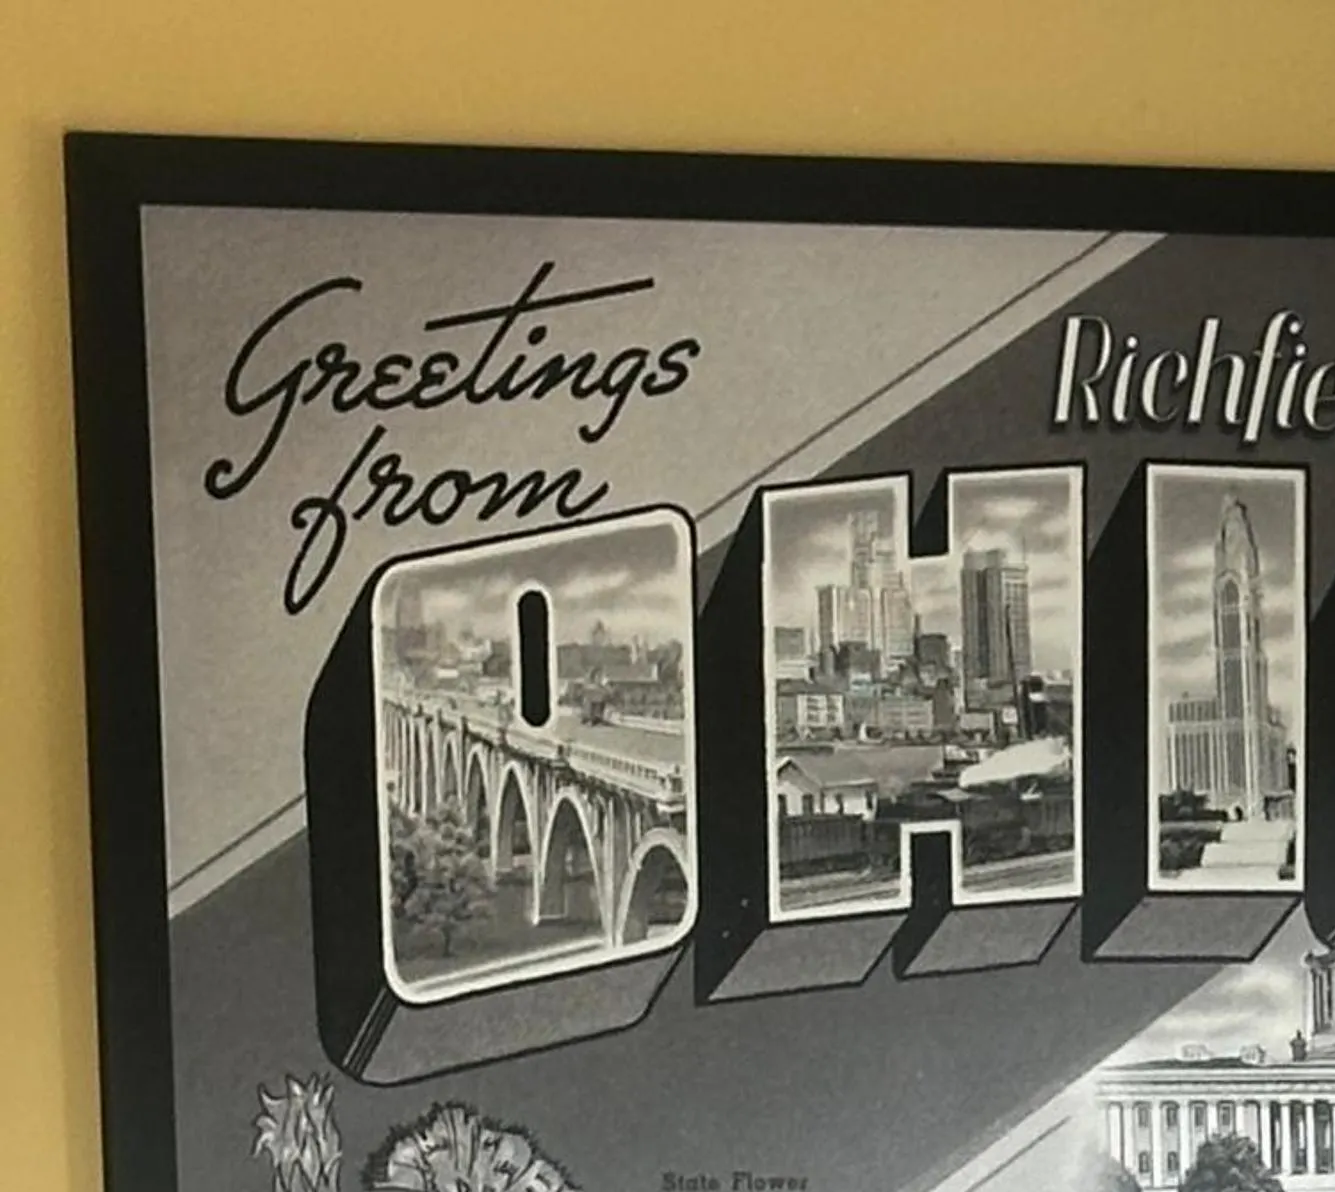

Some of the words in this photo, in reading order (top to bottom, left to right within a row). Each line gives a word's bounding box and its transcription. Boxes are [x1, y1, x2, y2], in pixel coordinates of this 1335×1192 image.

[205, 261, 700, 499] Greetings
[284, 425, 609, 615] from
[661, 1172, 721, 1192] State
[732, 1171, 809, 1192] Flower
